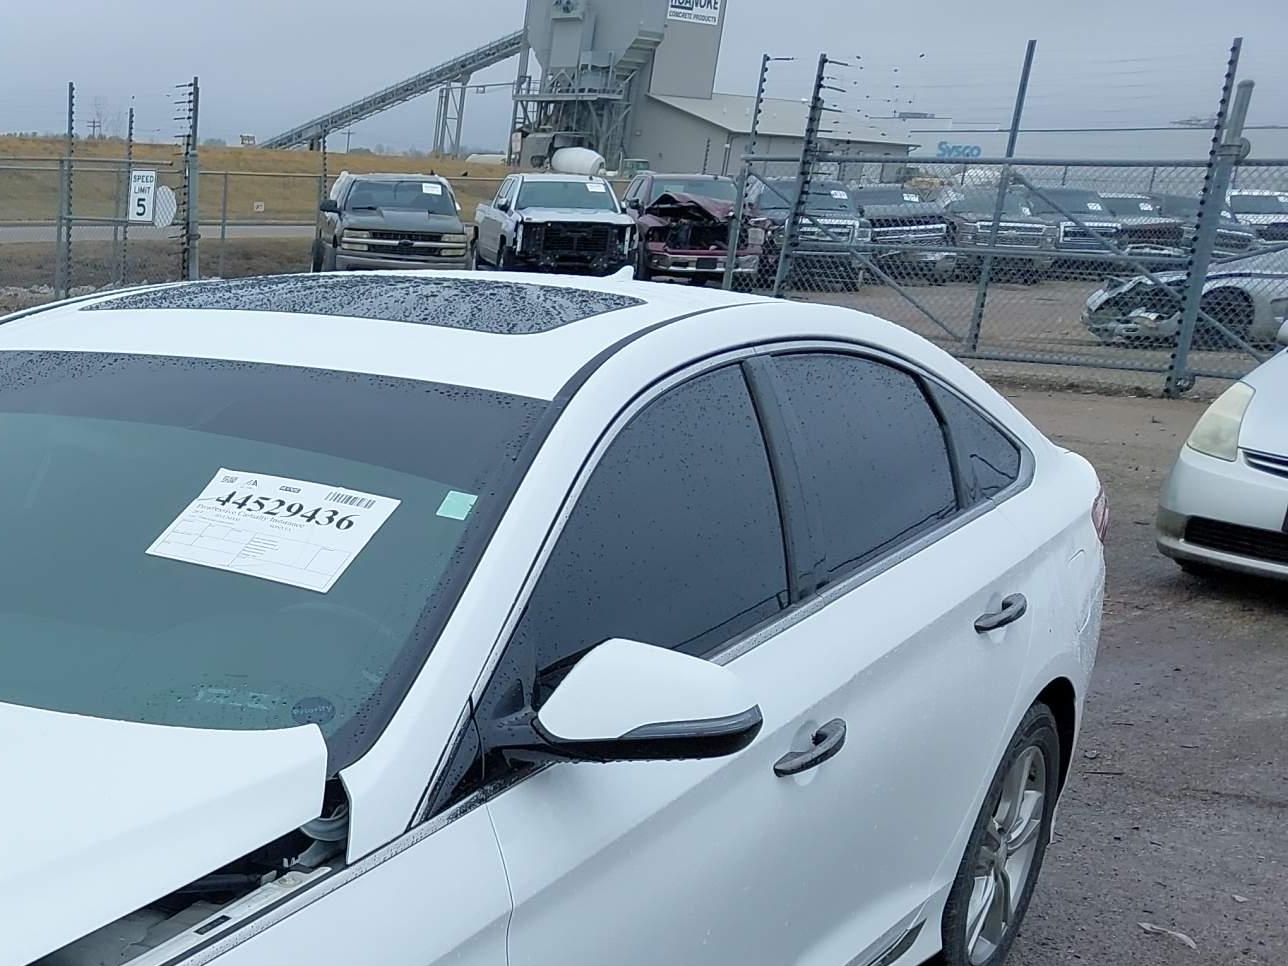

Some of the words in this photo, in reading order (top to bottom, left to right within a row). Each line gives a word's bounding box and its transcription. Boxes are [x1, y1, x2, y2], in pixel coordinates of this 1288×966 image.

[670, 0, 718, 10] NOKE
[133, 174, 154, 183] SPEED
[134, 186, 151, 194] LIMIT
[136, 198, 146, 216] 5
[216, 490, 360, 530] 44529436
